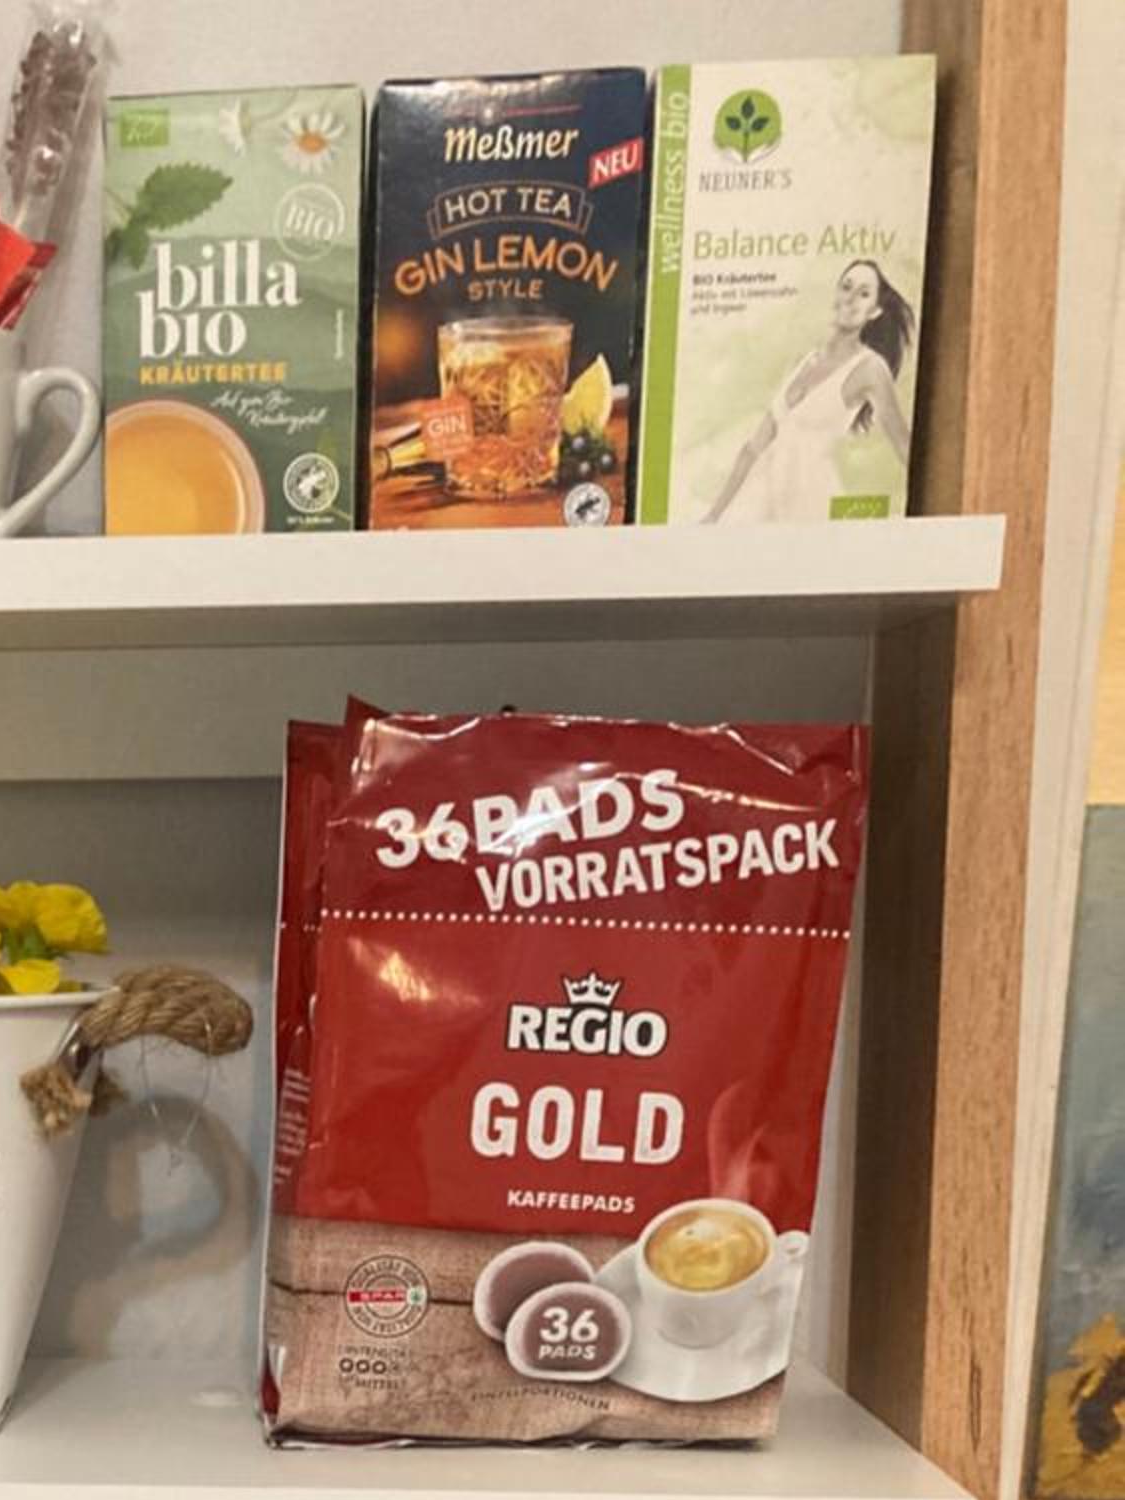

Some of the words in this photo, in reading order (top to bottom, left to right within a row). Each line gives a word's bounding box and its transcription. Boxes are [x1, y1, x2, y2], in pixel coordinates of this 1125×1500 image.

[661, 91, 691, 141] bio
[444, 126, 579, 163] Meßmer
[593, 146, 640, 182] NEU
[698, 168, 793, 193] NEUNER'S
[444, 186, 505, 222] HOT
[516, 187, 573, 219] TEA
[655, 147, 688, 275] wellness
[285, 205, 338, 241] BIO
[693, 227, 809, 260] Balance
[817, 223, 896, 255] Aktiv
[152, 239, 302, 310] billa
[393, 248, 465, 296] GIN
[473, 234, 619, 291] LEMON
[467, 279, 543, 301] STYLE
[135, 290, 248, 360] bio
[140, 358, 288, 386] KRÄUTERTEE
[427, 413, 468, 438] GIN
[374, 801, 470, 869] 36
[473, 769, 686, 855] PADS
[475, 819, 840, 912] VORRATSPACK
[506, 1003, 669, 1057] REGIO
[471, 1082, 686, 1166] GOLD
[506, 1189, 636, 1214] KAFFEEPADS
[538, 1306, 600, 1343] 36
[538, 1344, 597, 1361] PADS
